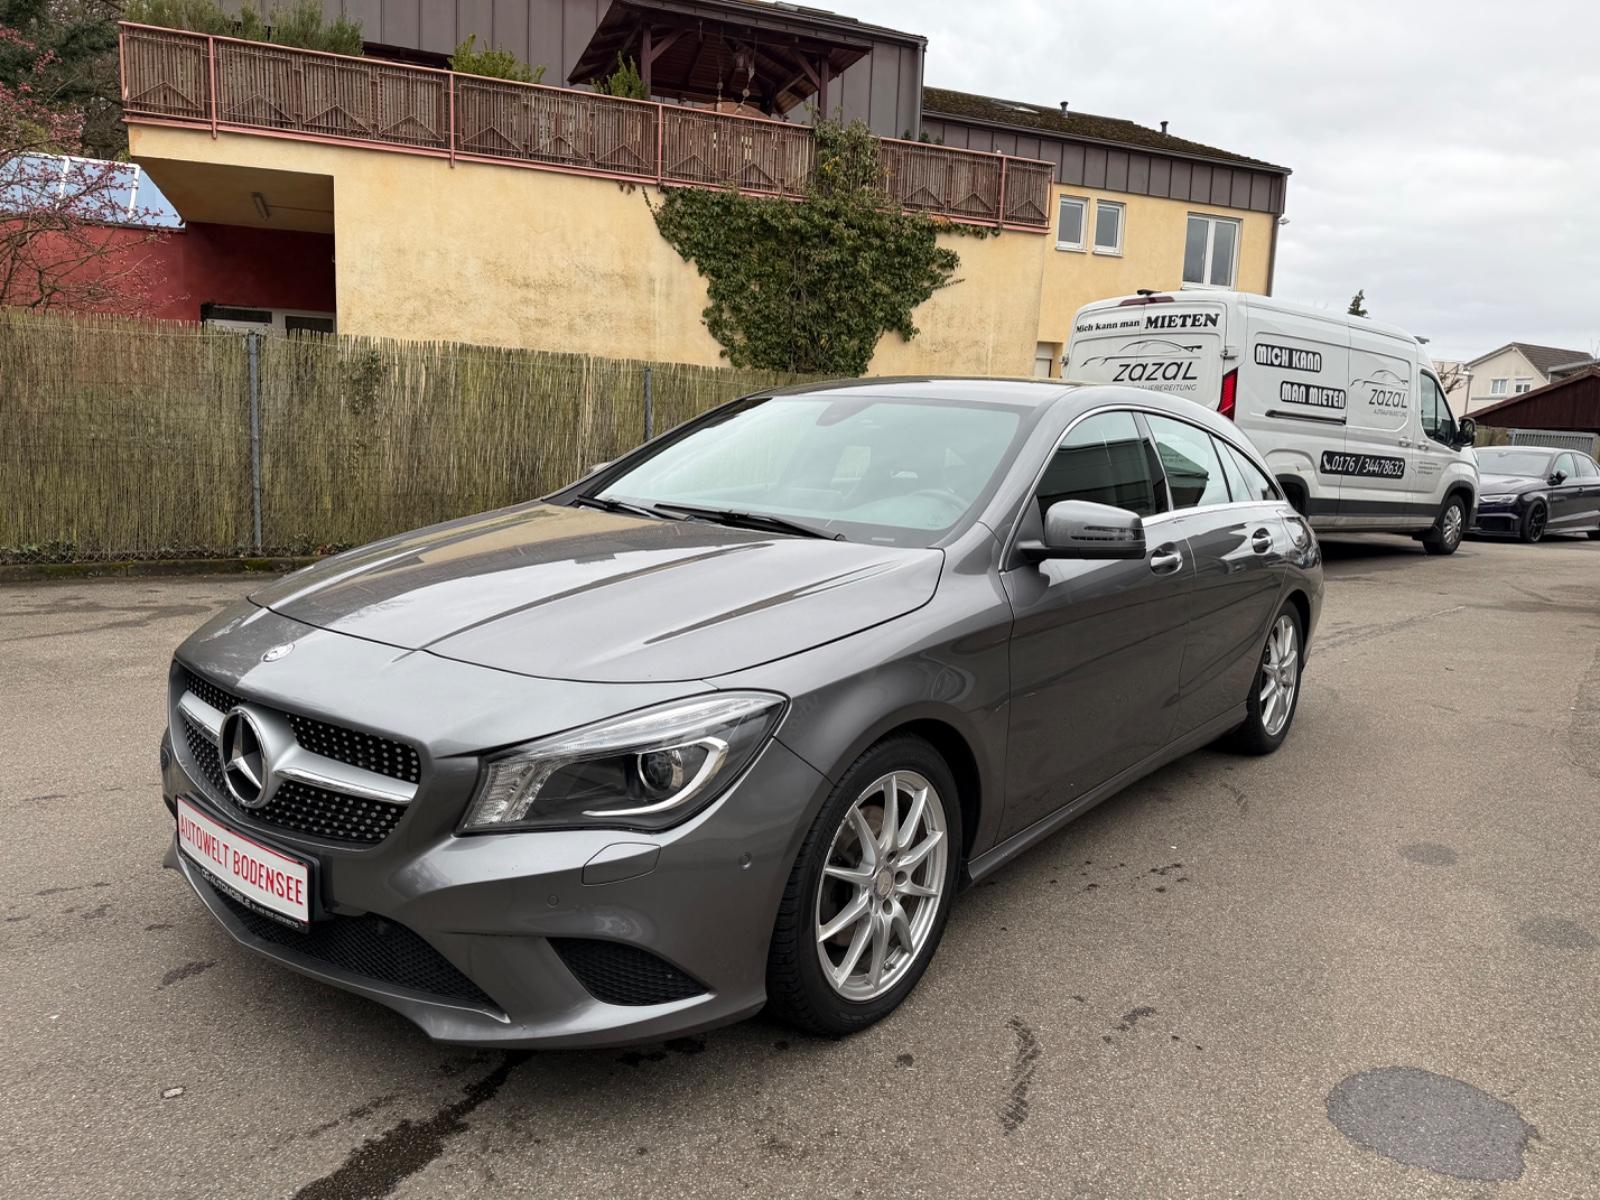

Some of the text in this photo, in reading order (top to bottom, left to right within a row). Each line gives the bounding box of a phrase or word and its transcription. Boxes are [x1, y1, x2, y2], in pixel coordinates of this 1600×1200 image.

[1076, 313, 1220, 333] Mich kann man MIETEN
[1256, 345, 1321, 371] MICH KANN
[1282, 383, 1345, 408] MAN MIETEN
[1332, 456, 1356, 472] 0176
[1363, 458, 1404, 475] 34478632
[181, 814, 303, 906] AUTOWELT BODENSEE
